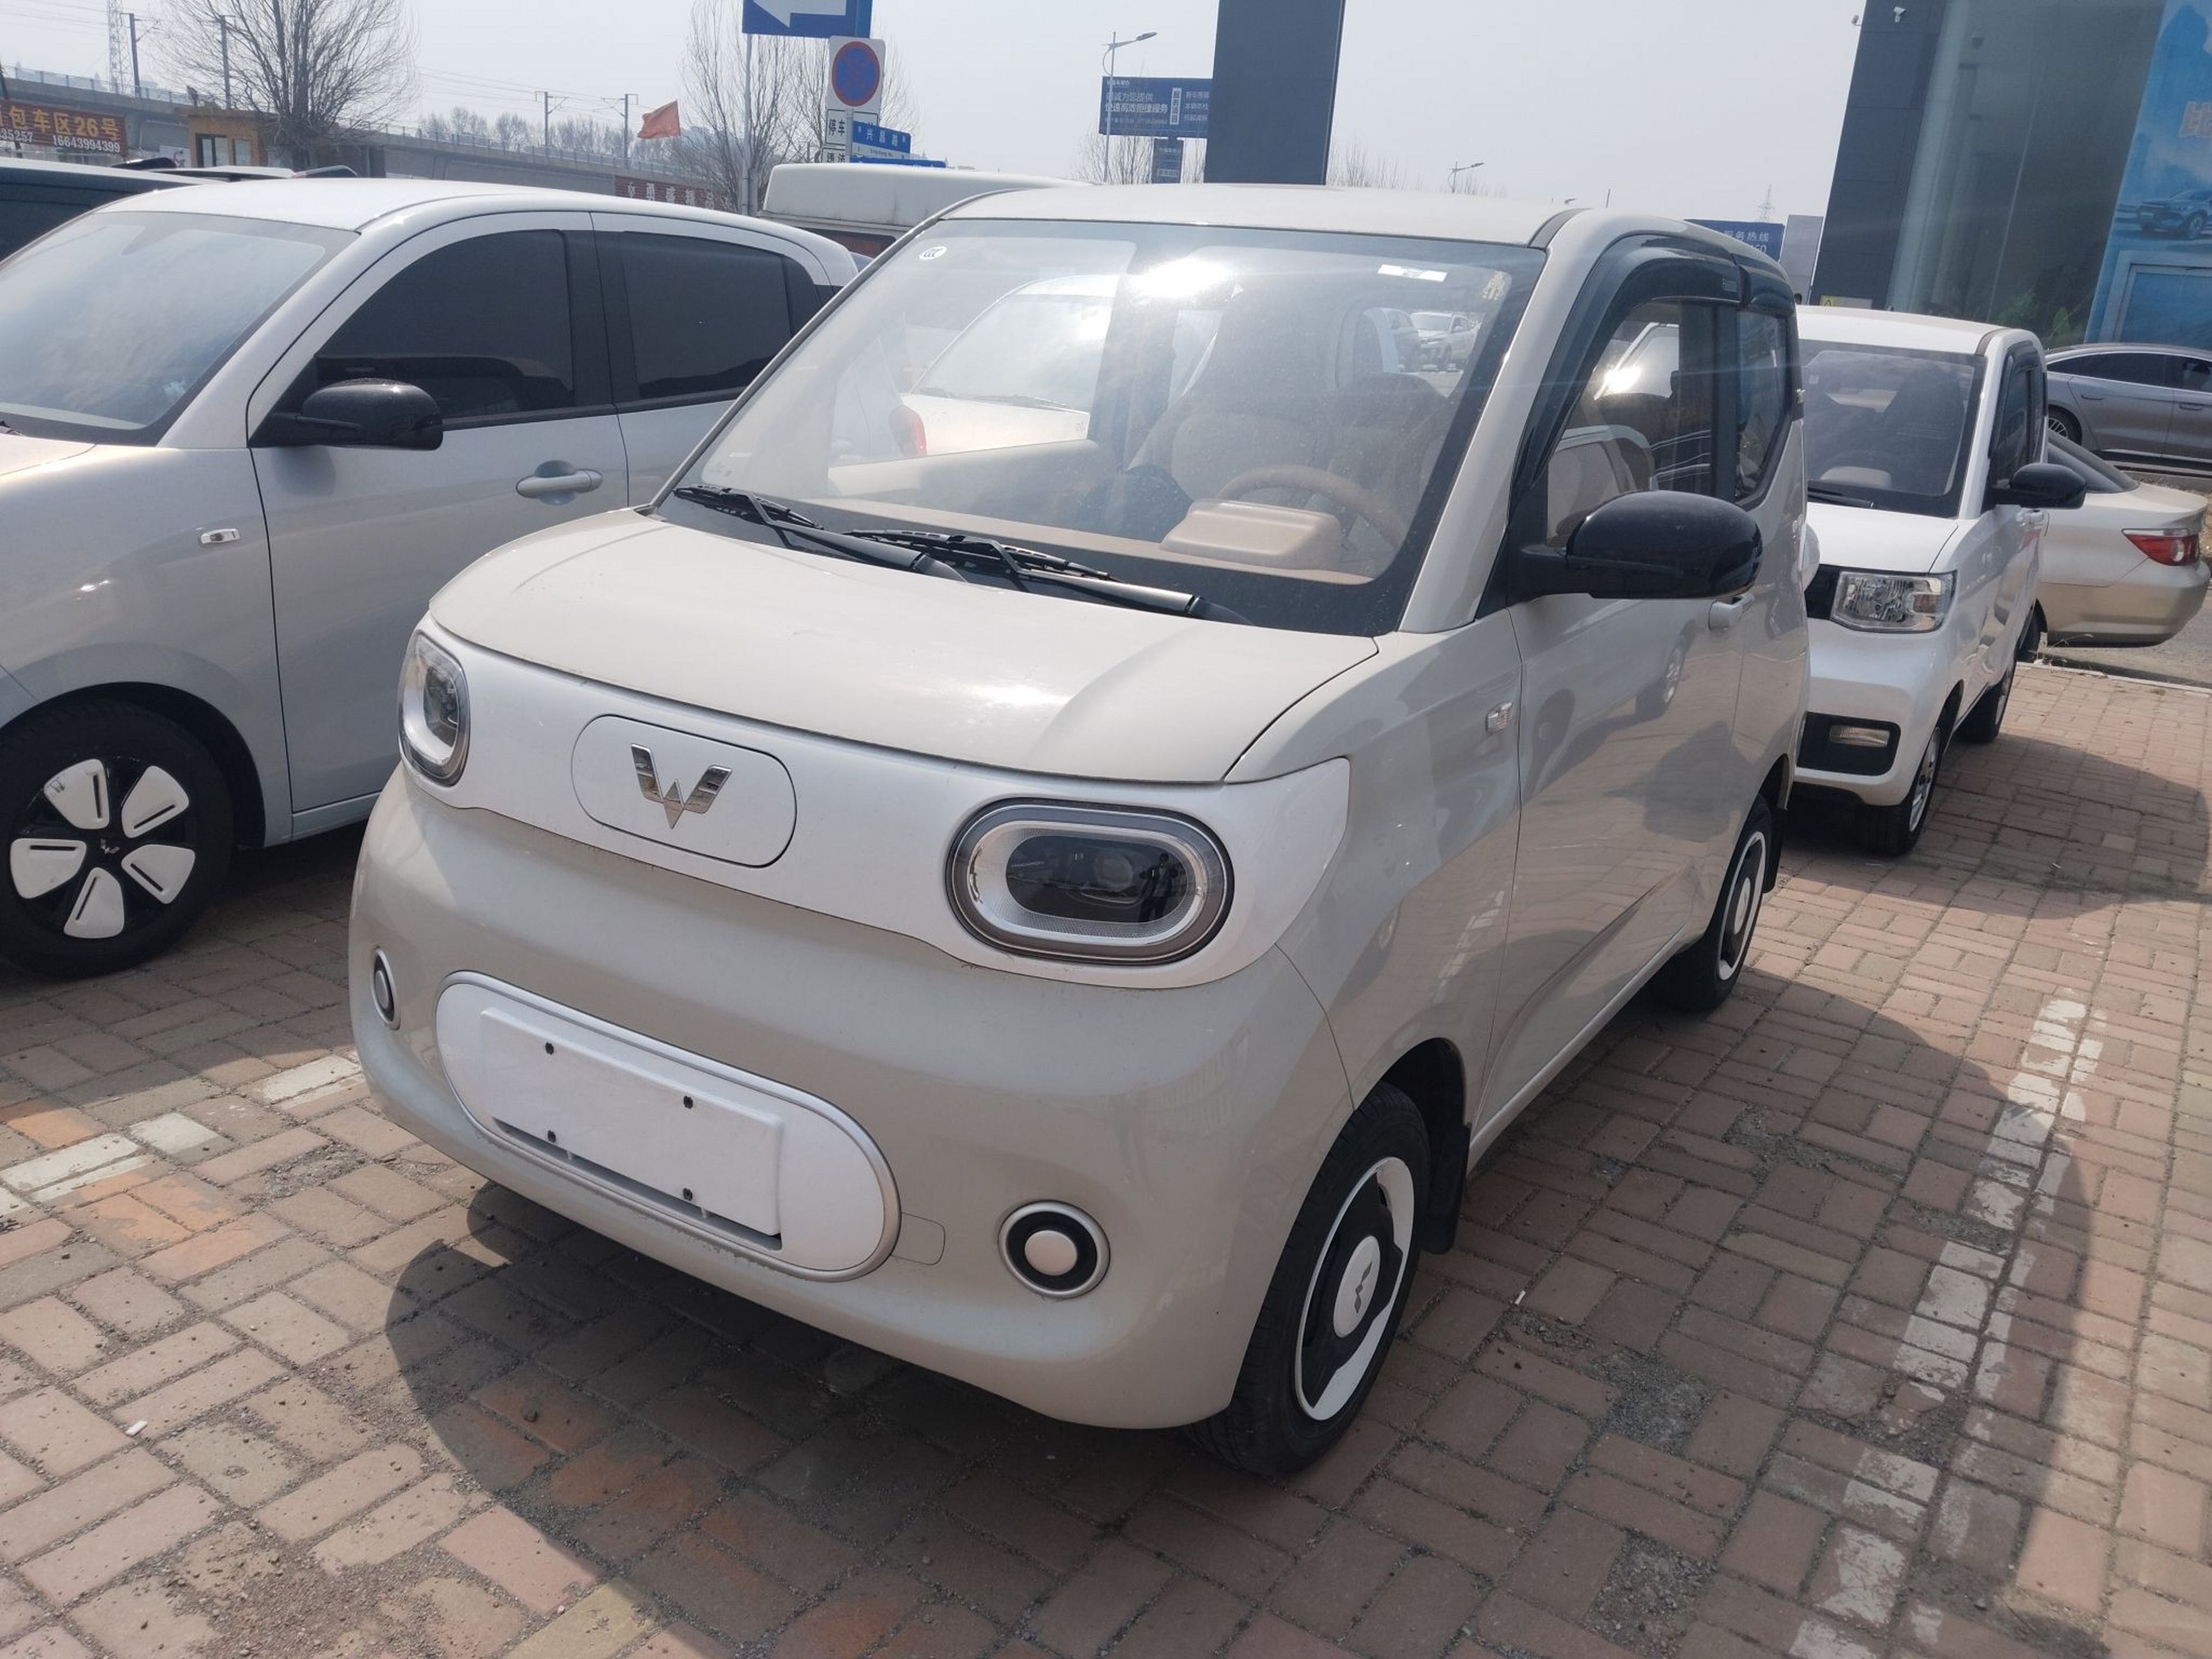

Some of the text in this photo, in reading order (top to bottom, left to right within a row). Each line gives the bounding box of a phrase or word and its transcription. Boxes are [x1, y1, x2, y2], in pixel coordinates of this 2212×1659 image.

[0, 105, 120, 140] 包车区26号
[828, 119, 845, 137] 停车
[52, 135, 120, 153] 16643994399
